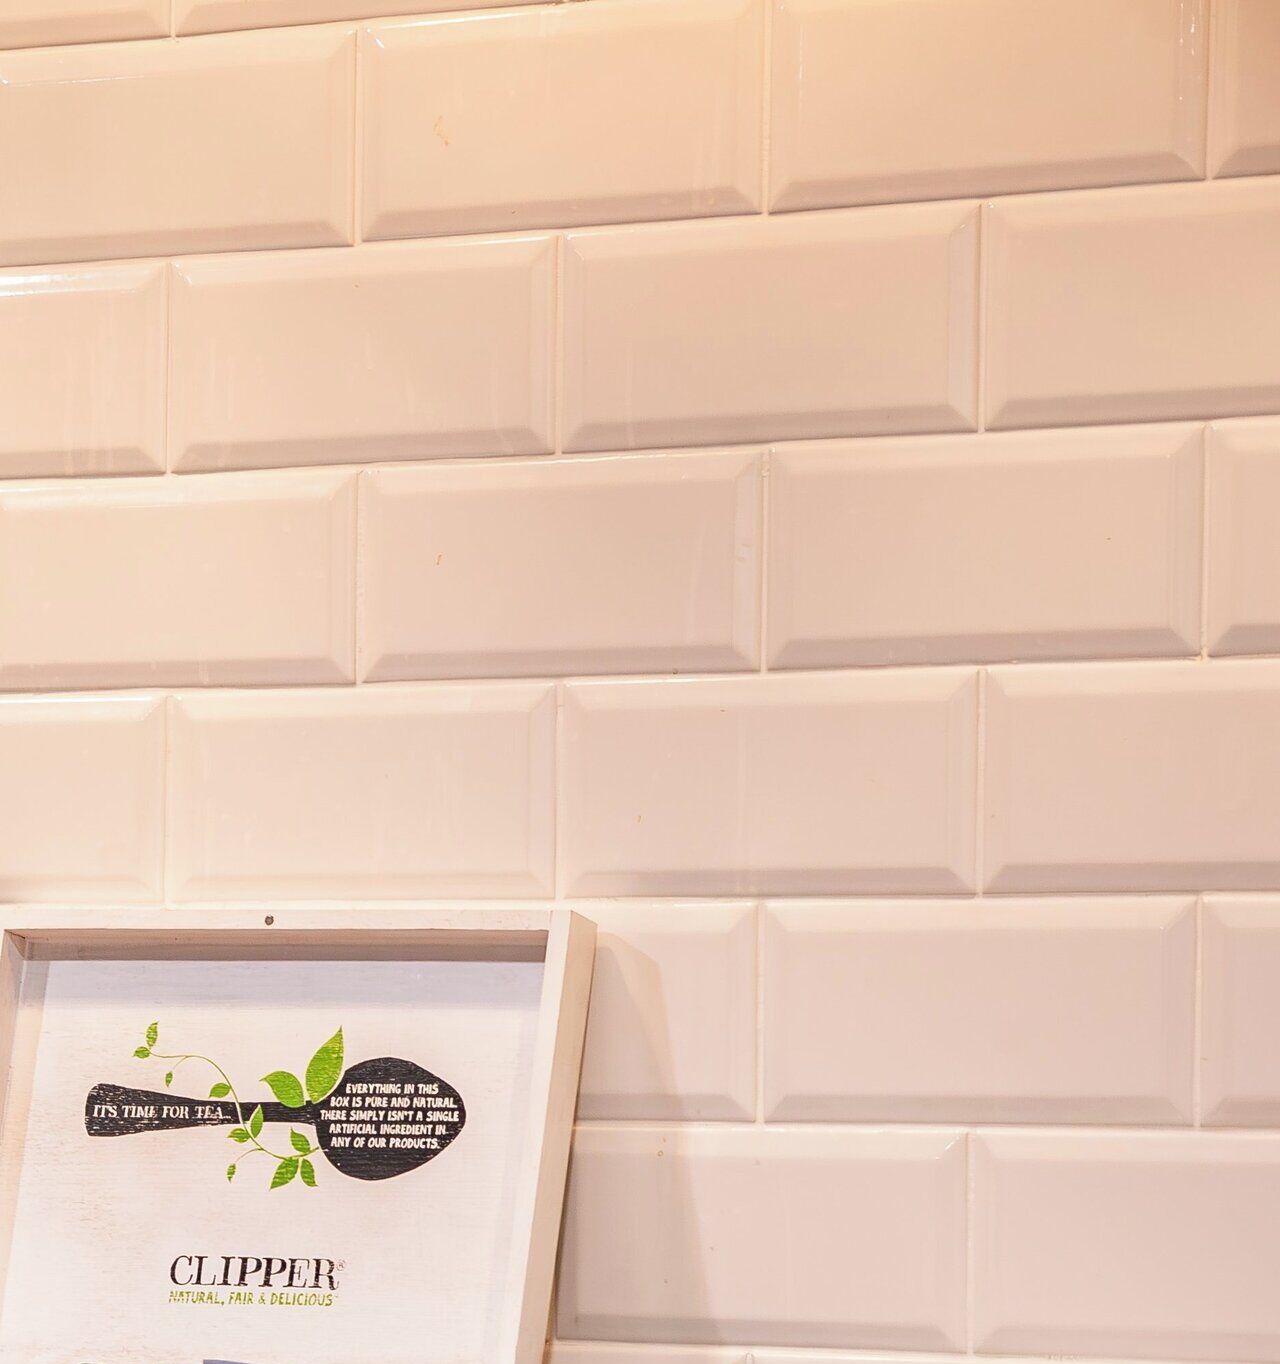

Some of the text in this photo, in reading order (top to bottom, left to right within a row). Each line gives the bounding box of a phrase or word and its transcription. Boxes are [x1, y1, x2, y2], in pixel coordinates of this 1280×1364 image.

[346, 1082, 439, 1095] EVERYTHING IN THIS
[330, 1097, 349, 1107] BOX
[352, 1097, 362, 1108] IS
[365, 1097, 388, 1108] PURE
[390, 1097, 410, 1108] AND
[122, 1105, 158, 1119] TIME
[162, 1106, 190, 1119] FOR
[320, 1110, 459, 1122] THERE SIMPLY ISN'T A SINGLE
[329, 1123, 446, 1135] ARTIFICIAL INGREDIENT IN
[330, 1136, 440, 1149] ANY OF OUR PRODUCTS.
[169, 1291, 333, 1307] NATURAL, FAIR & DELICIOUS
